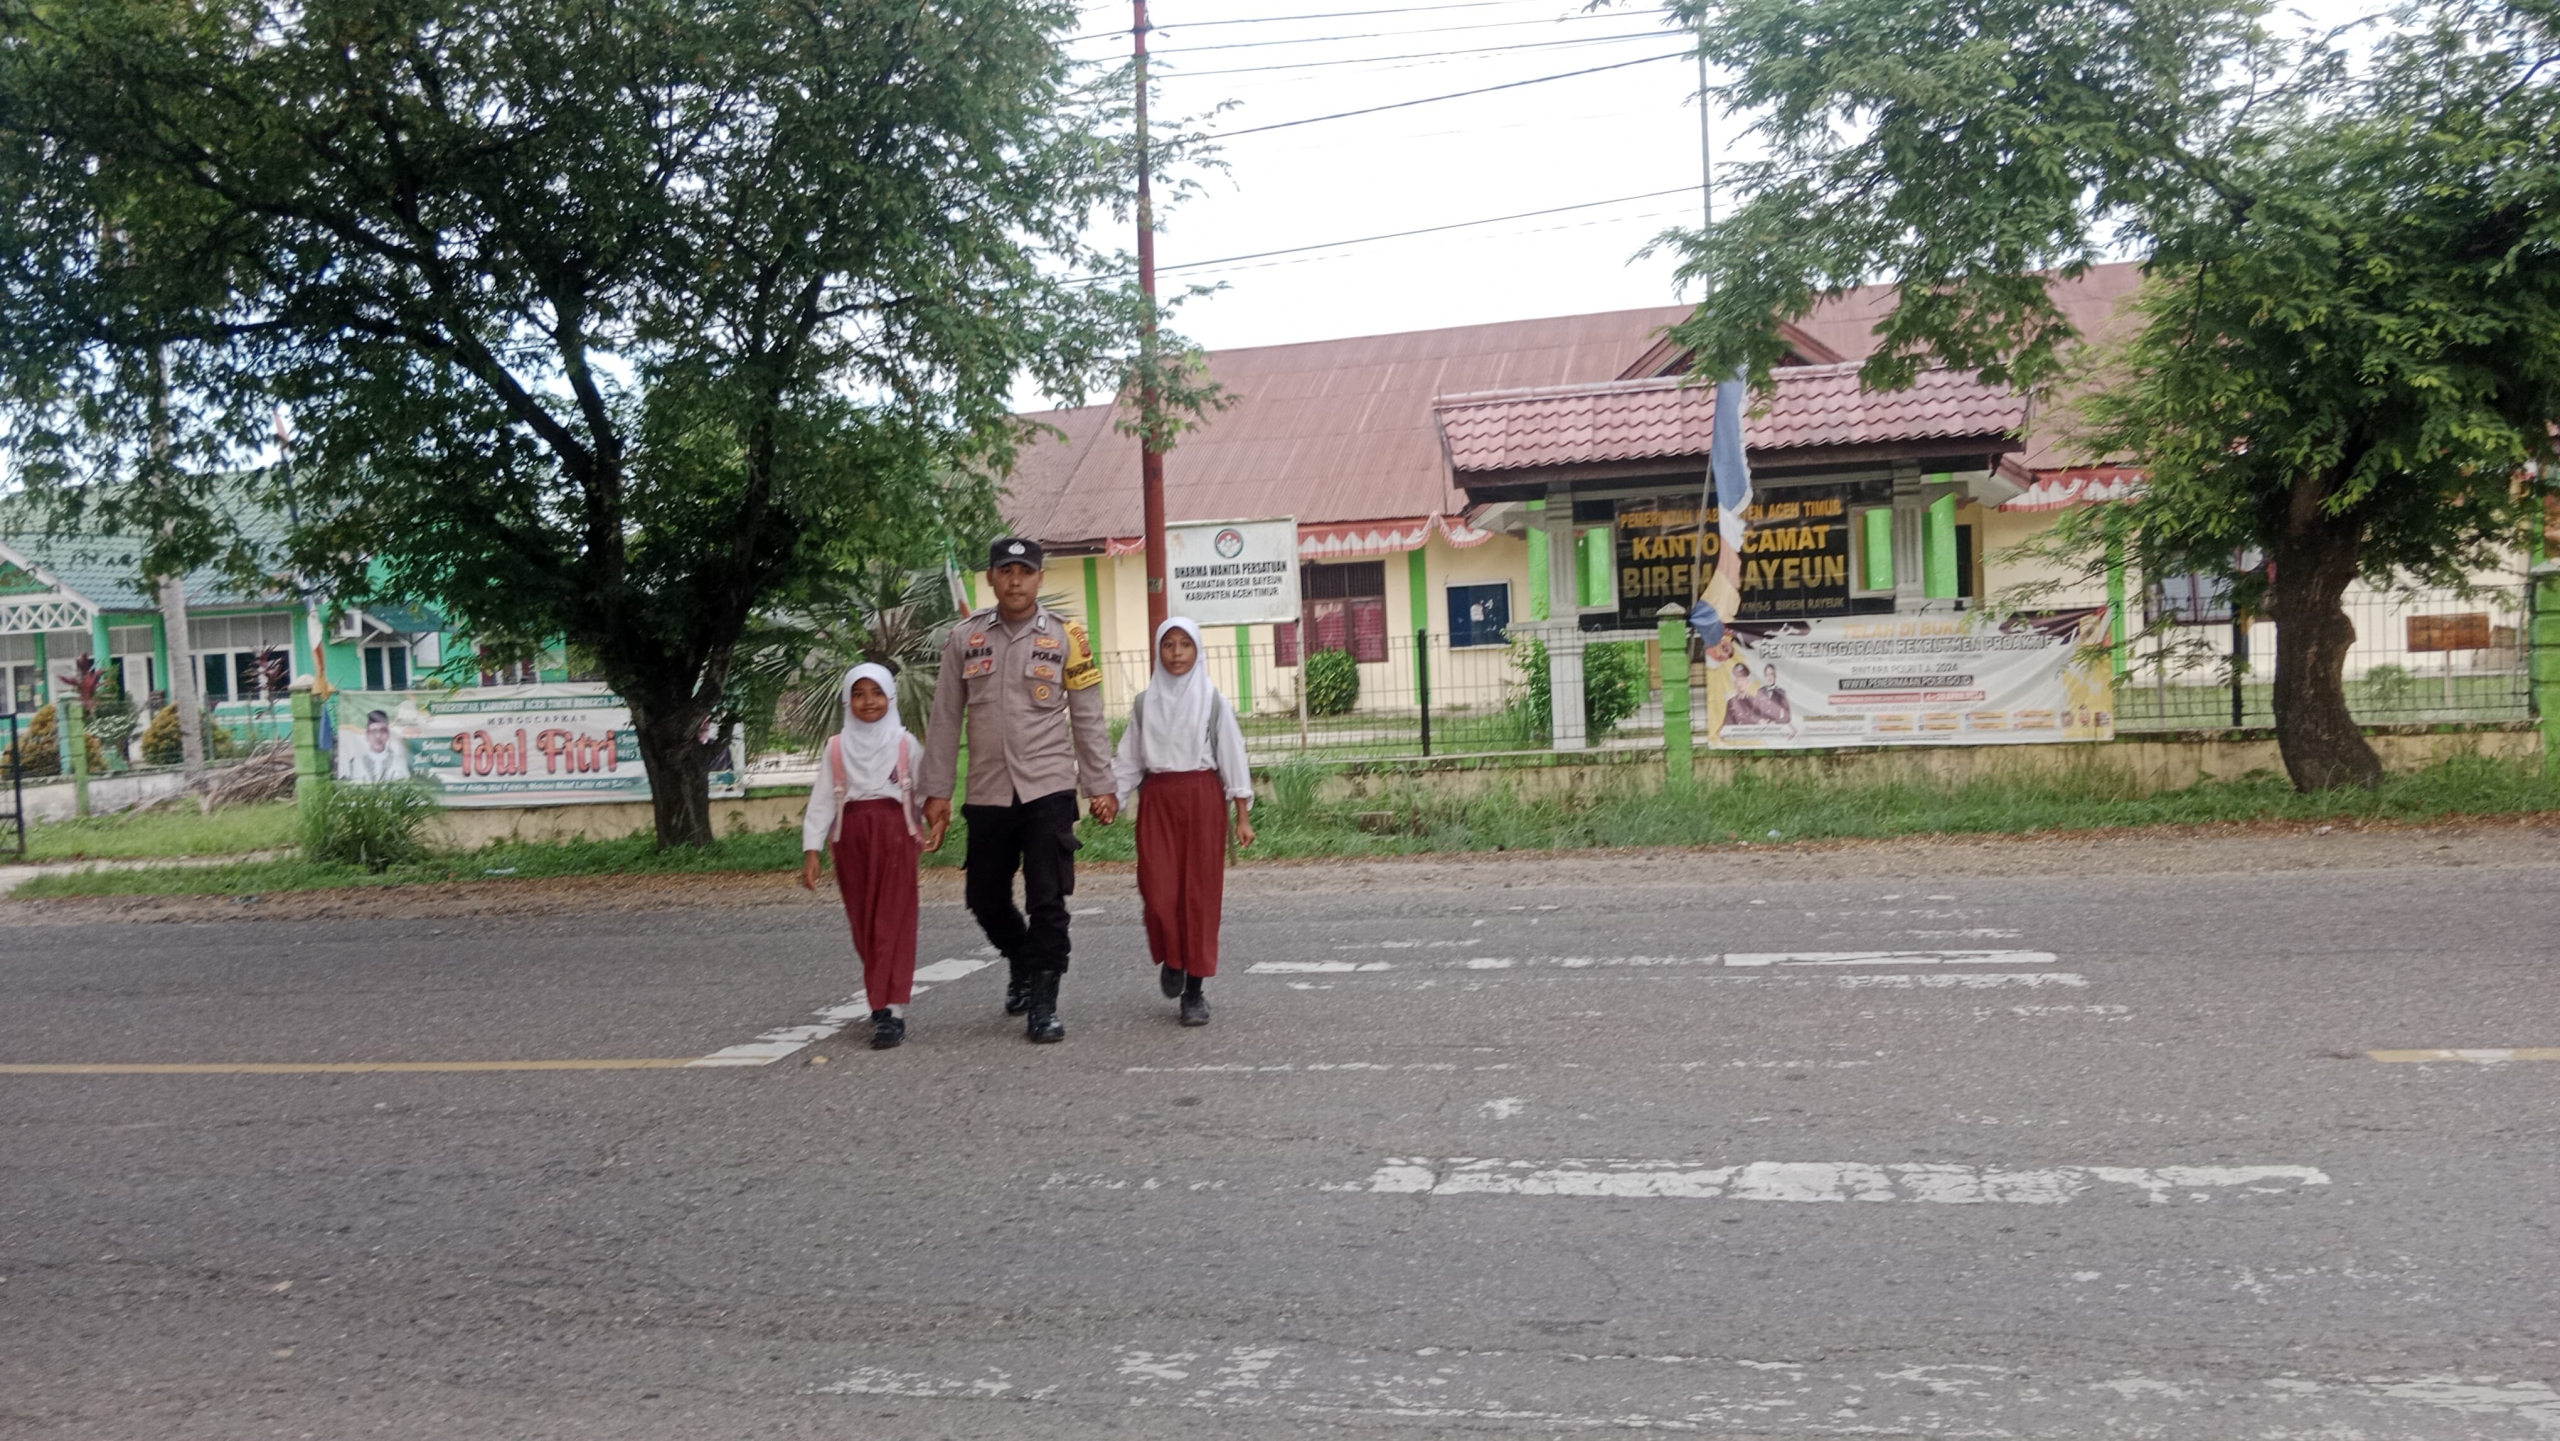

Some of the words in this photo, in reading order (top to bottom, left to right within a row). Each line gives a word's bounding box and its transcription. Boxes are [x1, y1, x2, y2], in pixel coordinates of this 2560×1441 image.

[1620, 510, 1692, 529] PEMERINTAH
[1768, 502, 1800, 520] ACEH
[1803, 499, 1842, 518] TIMUR
[1633, 532, 1719, 560] KANTO
[1742, 525, 1830, 553] CAMAT
[1175, 566, 1208, 579] DHARMA
[1210, 563, 1240, 577] WANITA
[1242, 561, 1287, 575] PERSATUAN
[1743, 555, 1845, 592] AYEUN
[1181, 579, 1226, 590] KECAMATAN
[1227, 577, 1250, 588] BIREM
[1252, 575, 1283, 587] BAYEUN
[1185, 590, 1230, 602] KABUPATEN
[1231, 589, 1252, 599] ACEH
[1253, 586, 1279, 597] TIMUR
[1843, 624, 1895, 638] TELAH
[1900, 623, 1917, 636] DI
[1920, 621, 1967, 635] BUKA
[964, 647, 993, 659] ARIS
[1897, 636, 1983, 654] REKRUTMEN
[1032, 651, 1062, 664] POLRI
[525, 700, 547, 711] ACEH
[452, 728, 527, 777] Idul
[536, 728, 617, 774] Fitri
